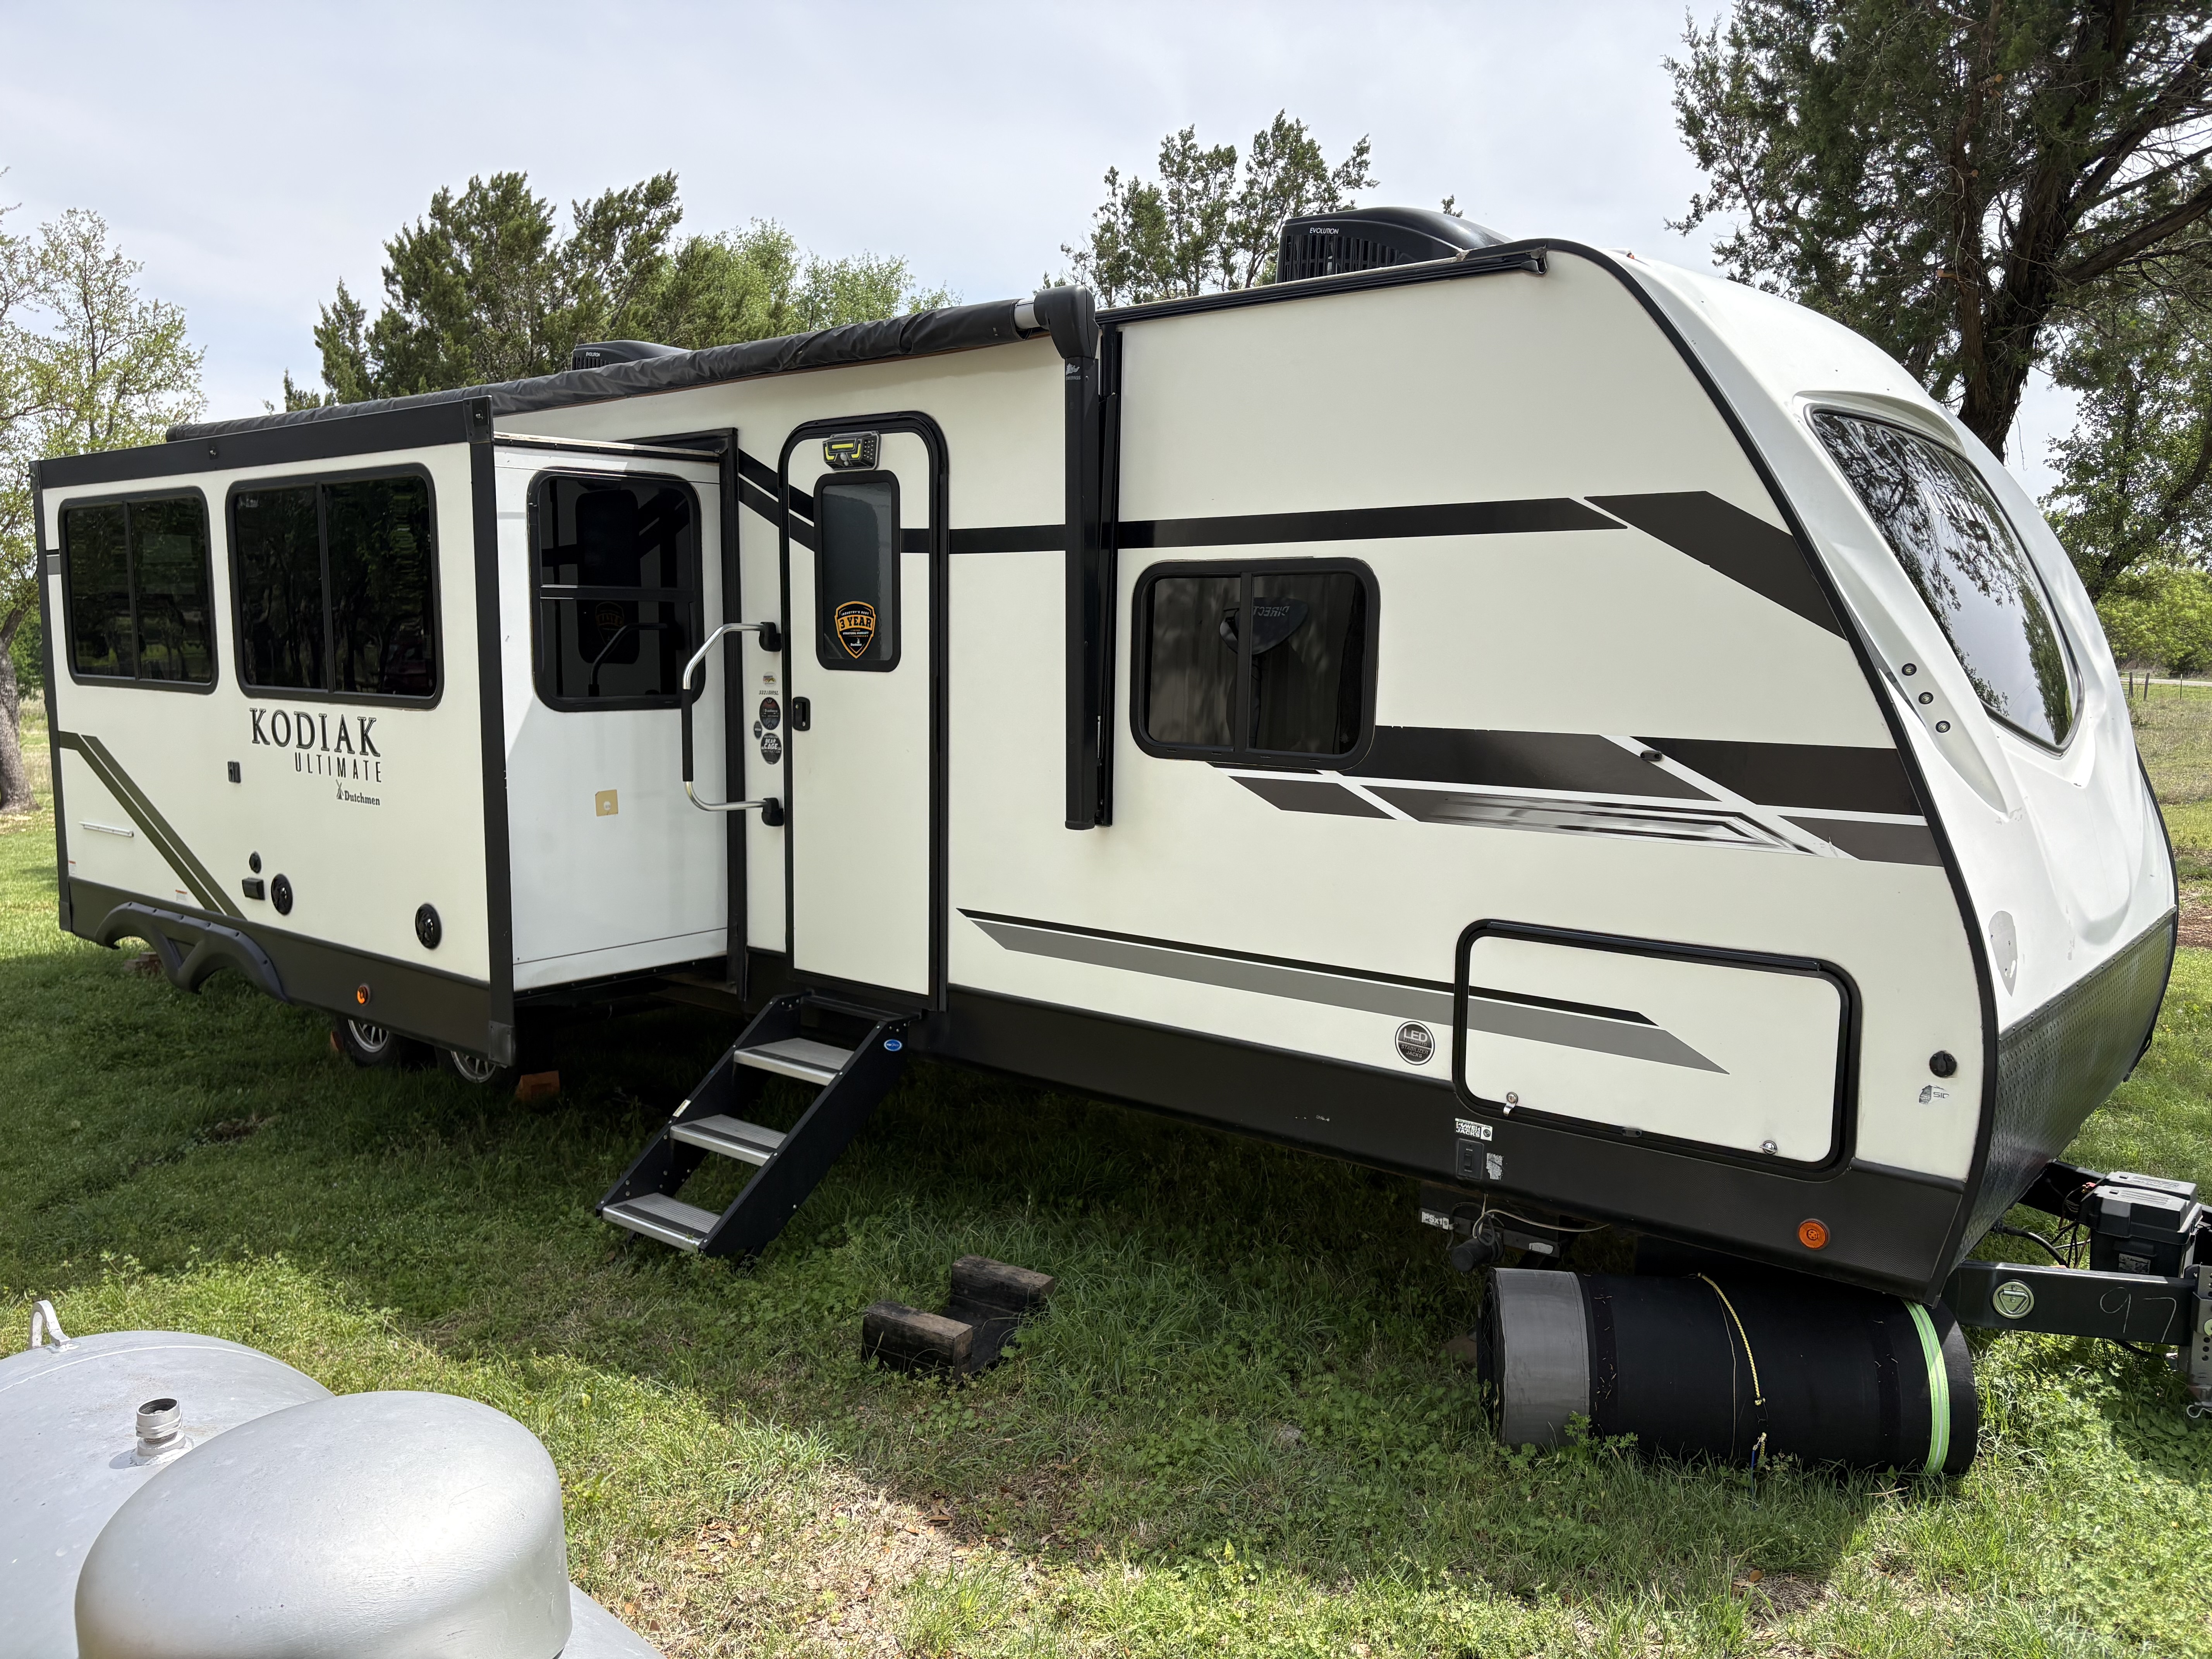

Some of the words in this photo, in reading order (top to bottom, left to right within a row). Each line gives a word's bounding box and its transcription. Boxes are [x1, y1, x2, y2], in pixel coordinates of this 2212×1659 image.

[840, 619, 845, 629] 3
[847, 616, 871, 628] YEAR
[249, 708, 381, 757] KODIAK
[295, 752, 381, 783] ULTIMATE
[344, 790, 380, 806] Dutchmen
[1403, 1028, 1428, 1042] LED
[1401, 1044, 1428, 1055] STABILIZER
[1456, 1128, 1480, 1137] JACKS
[2100, 1287, 2177, 1343] 97
